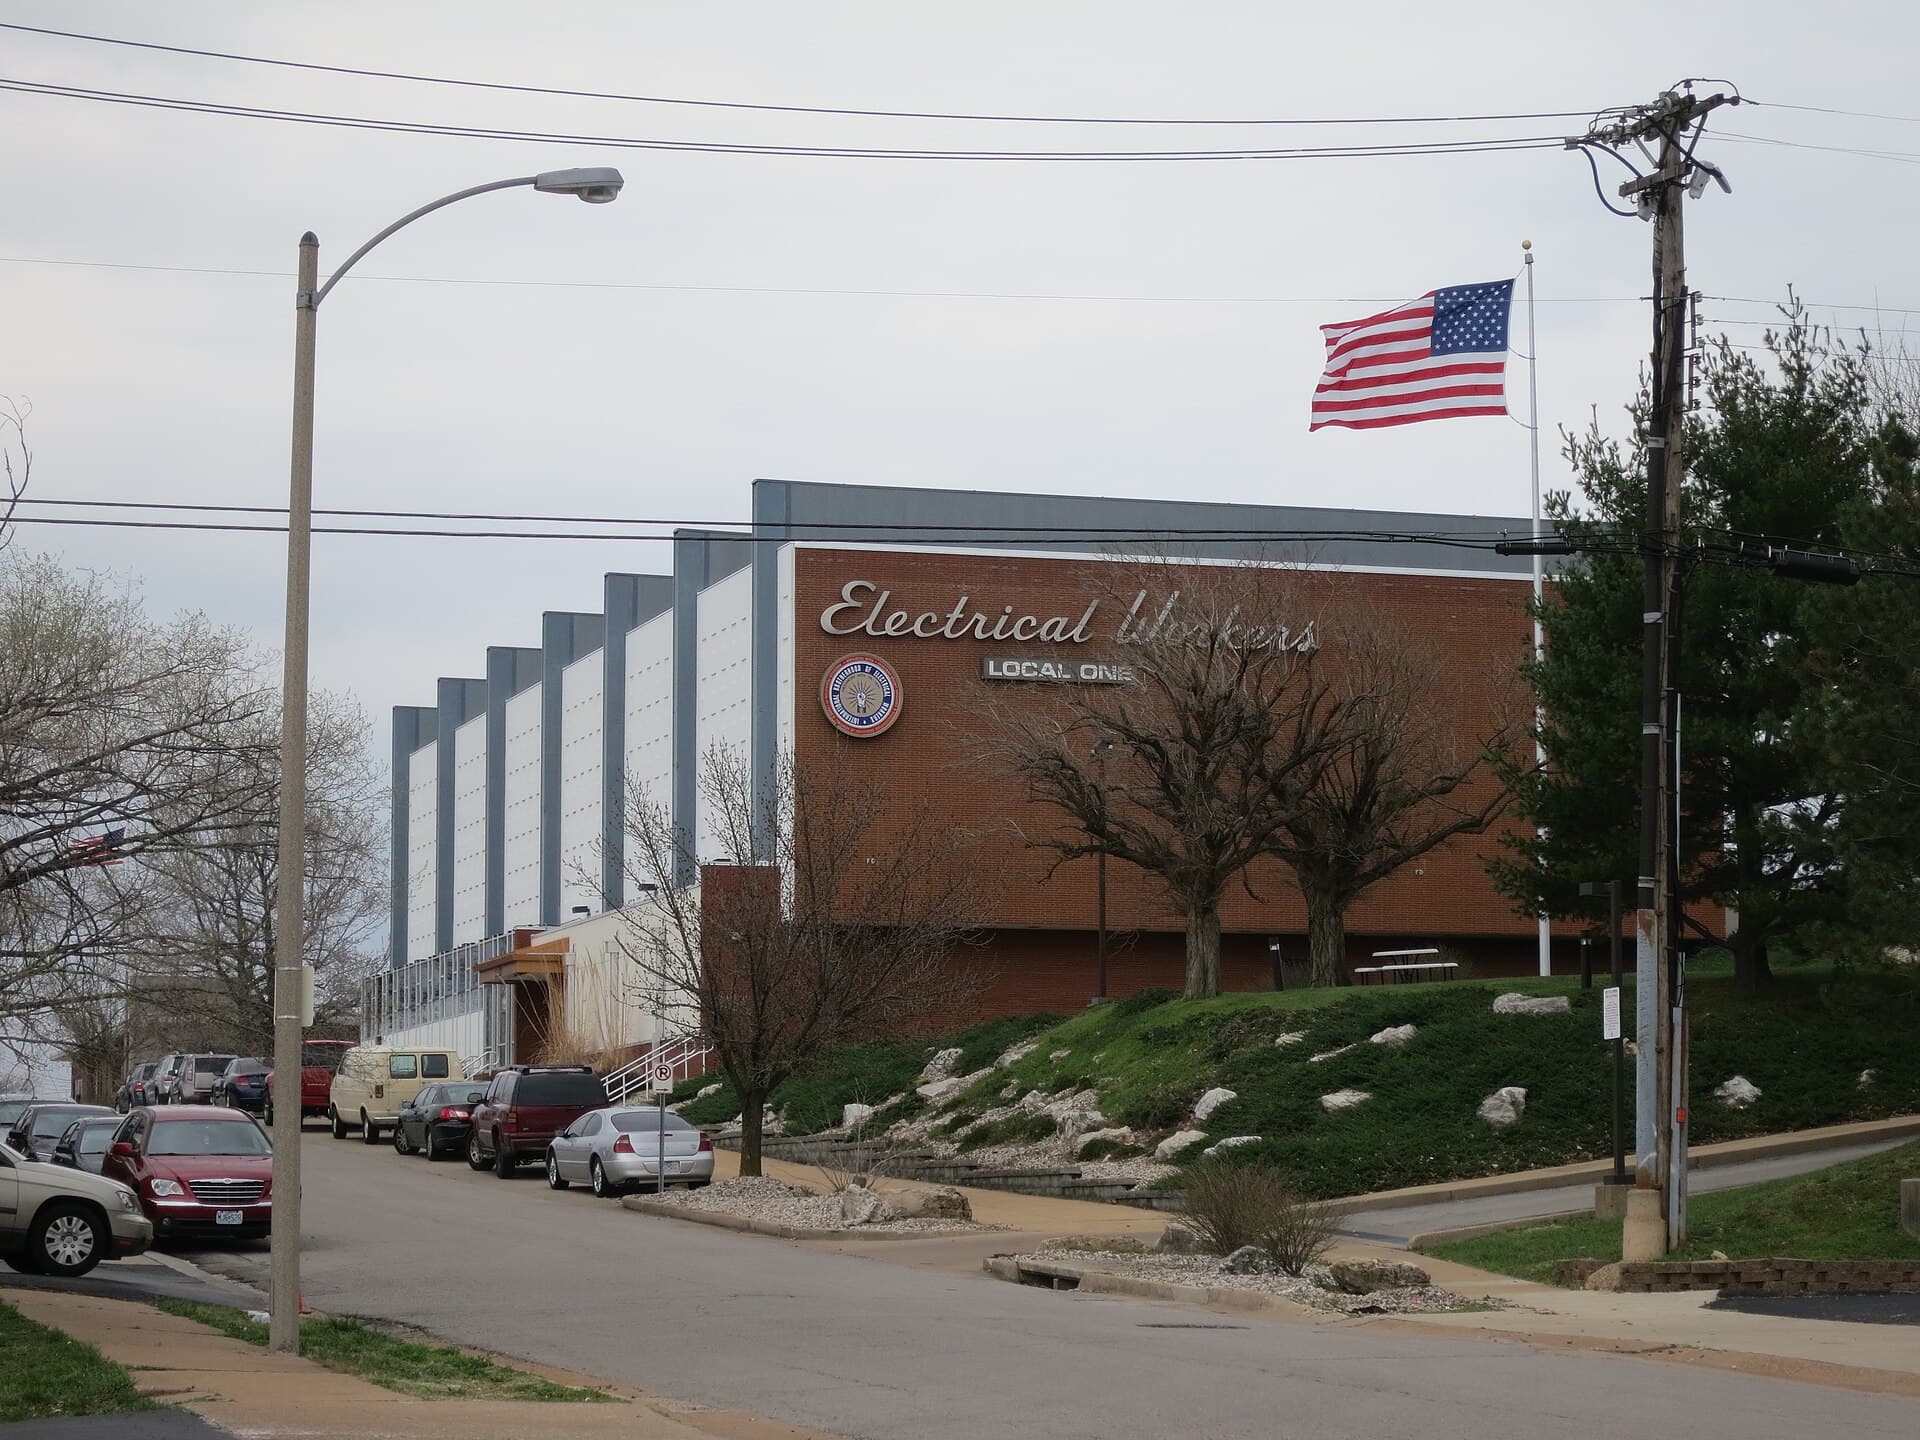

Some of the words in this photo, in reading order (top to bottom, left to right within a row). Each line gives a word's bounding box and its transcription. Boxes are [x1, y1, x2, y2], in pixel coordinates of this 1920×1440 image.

[820, 580, 1099, 643] Electrical
[988, 660, 1072, 679] LOCAL
[1079, 664, 1132, 681] ONE
